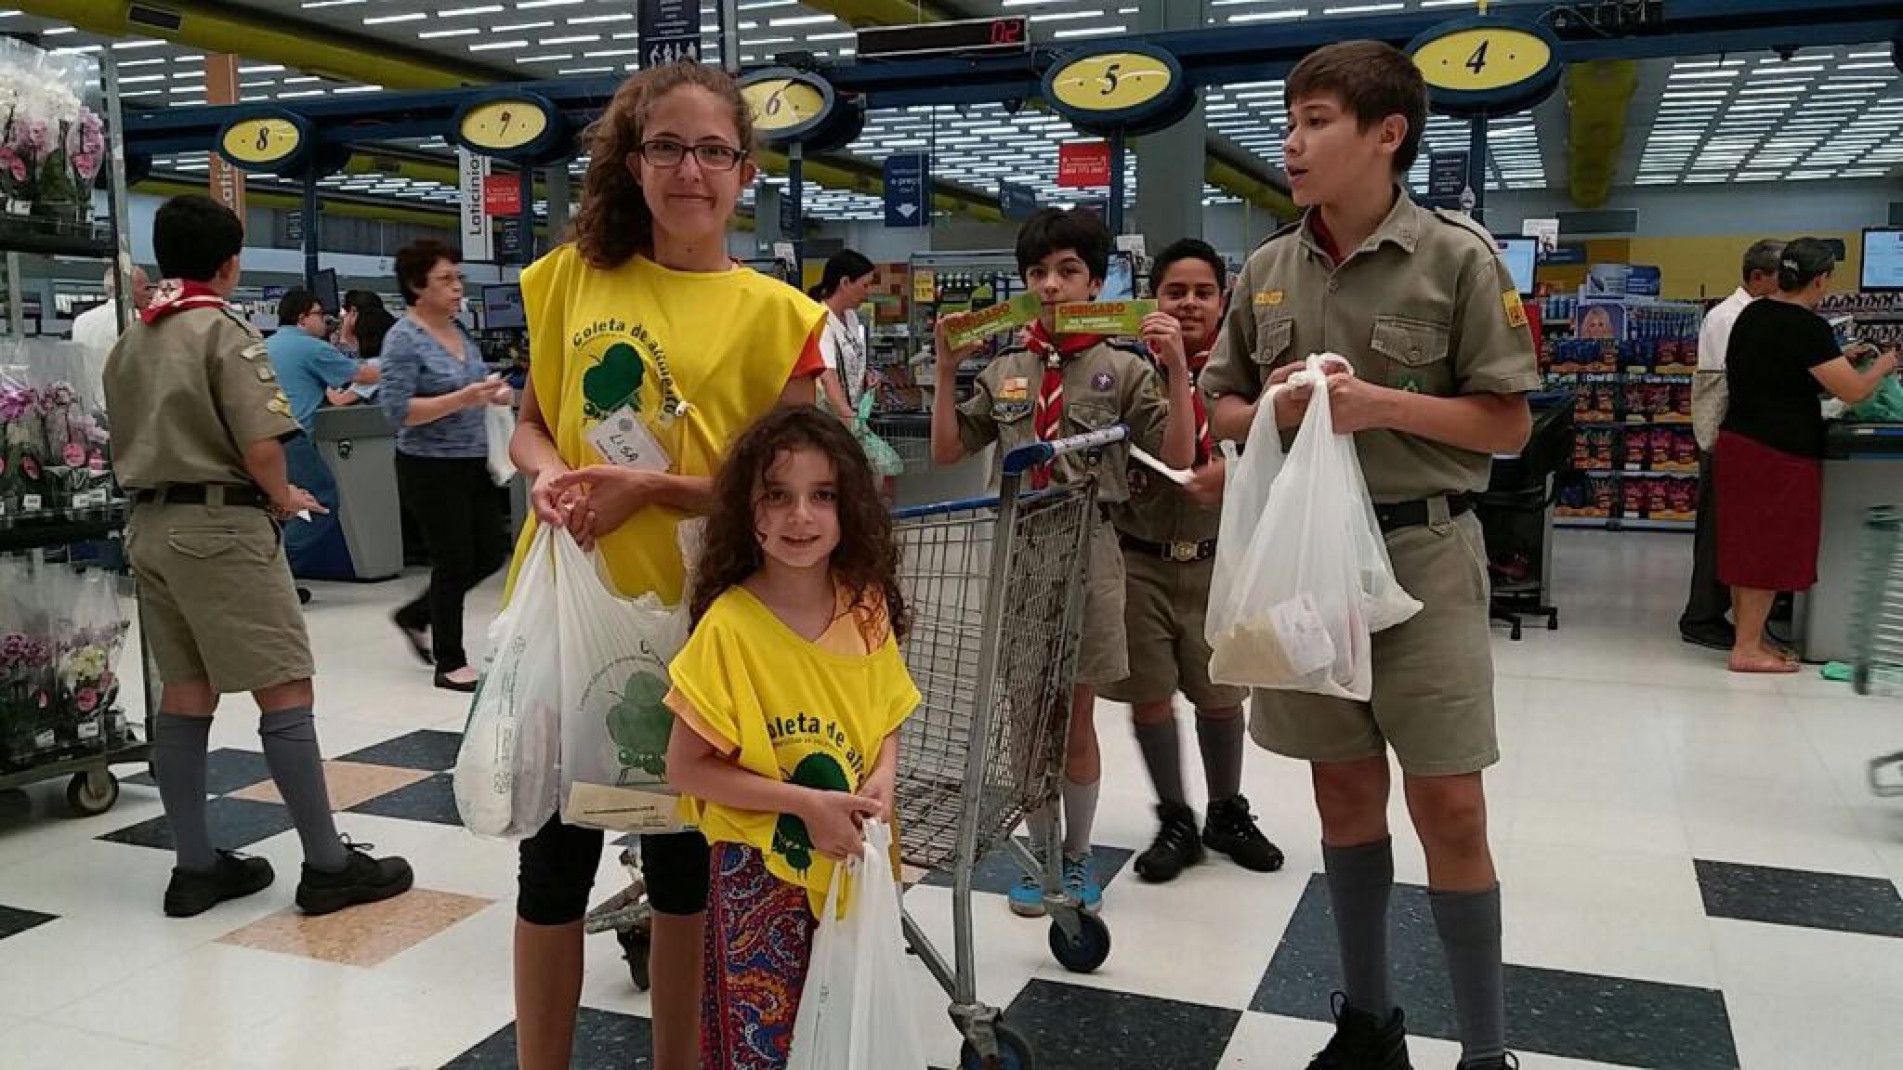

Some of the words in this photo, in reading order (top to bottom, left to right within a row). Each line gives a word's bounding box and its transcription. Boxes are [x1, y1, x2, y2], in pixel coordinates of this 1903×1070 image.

[991, 21, 1020, 44] 02
[1465, 39, 1489, 74] 4
[1100, 63, 1121, 95] 5
[765, 89, 780, 116] 6
[255, 127, 270, 151] 8
[573, 317, 626, 347] Coleta
[630, 322, 649, 343] de
[767, 712, 821, 739] oleta
[826, 721, 845, 748] de
